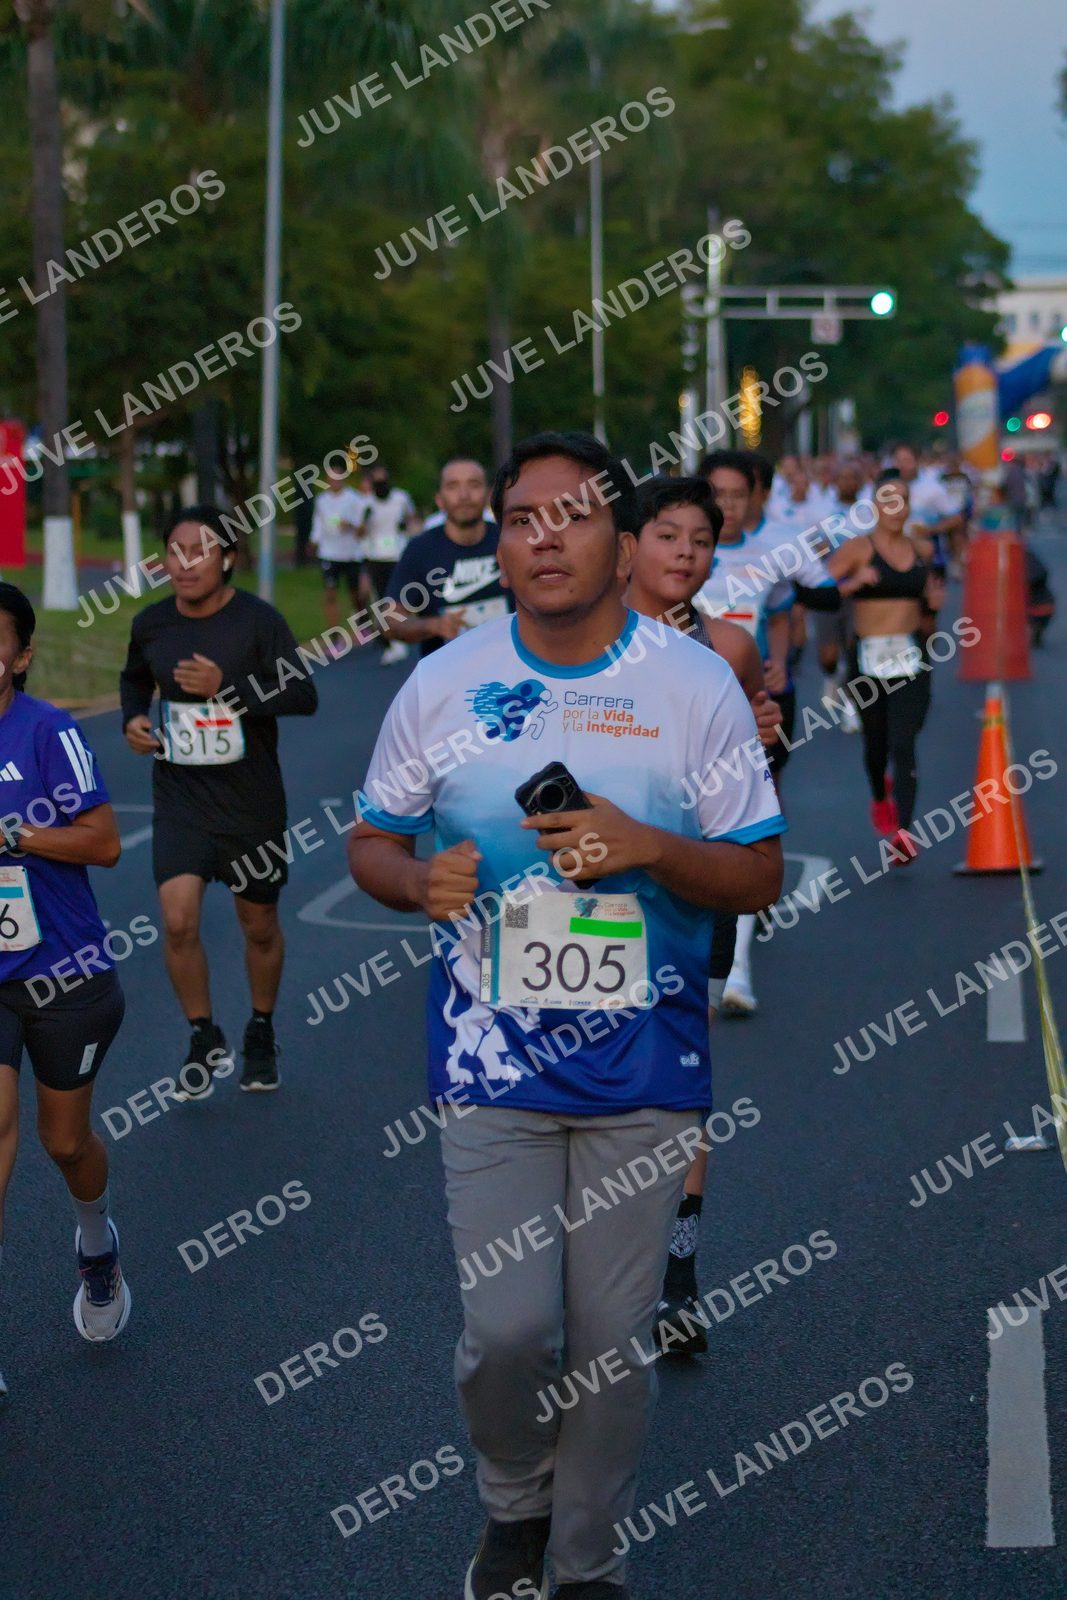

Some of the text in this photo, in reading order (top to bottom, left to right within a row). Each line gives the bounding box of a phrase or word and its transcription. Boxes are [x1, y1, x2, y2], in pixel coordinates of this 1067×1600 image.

[564, 691, 634, 709] Carrera
[563, 708, 634, 723] por la Vida
[562, 720, 660, 738] y la Integridad
[179, 729, 231, 756] 315
[522, 941, 626, 993] 305
[481, 973, 490, 989] 305
